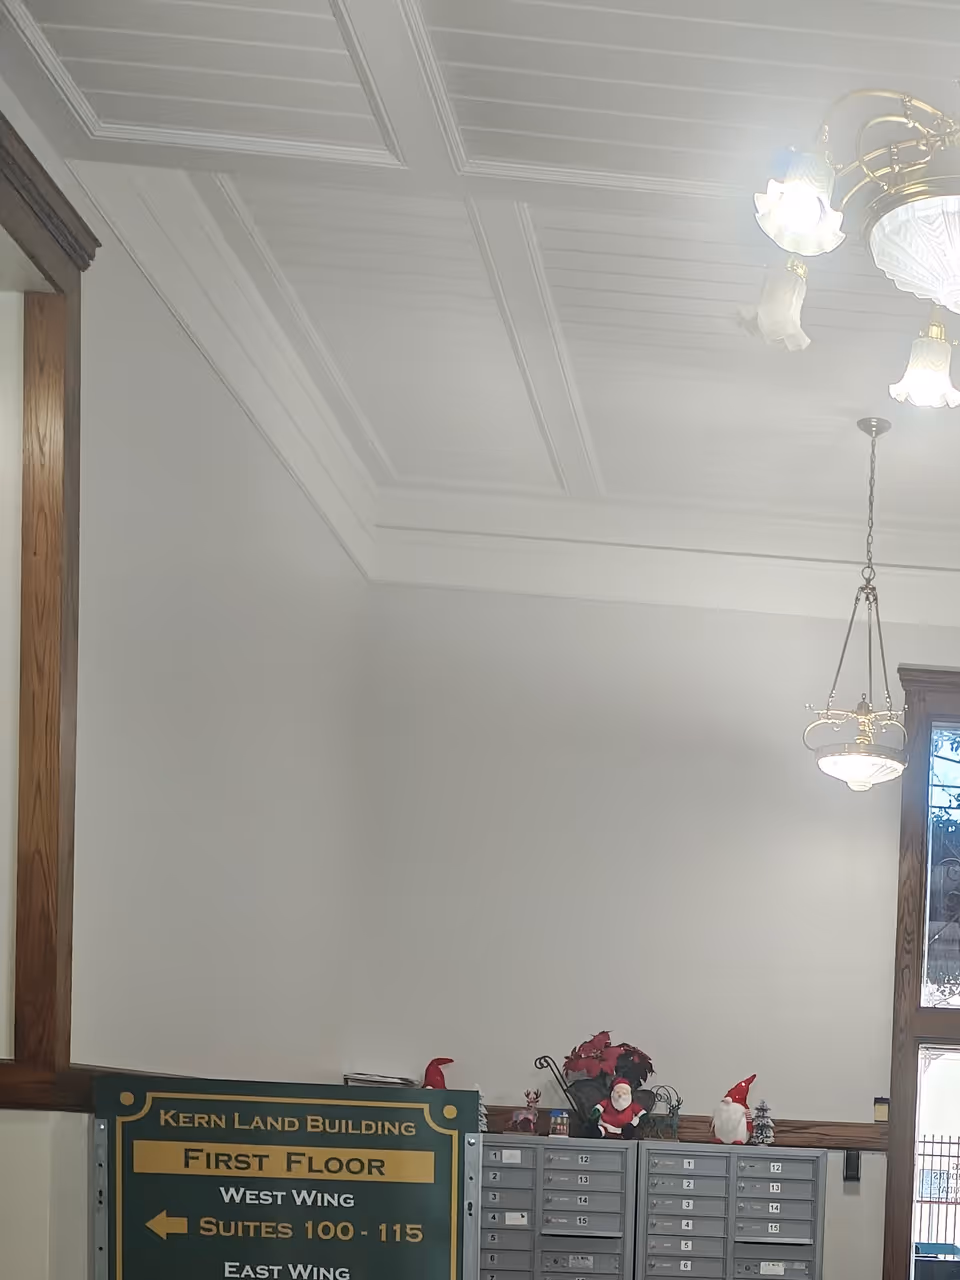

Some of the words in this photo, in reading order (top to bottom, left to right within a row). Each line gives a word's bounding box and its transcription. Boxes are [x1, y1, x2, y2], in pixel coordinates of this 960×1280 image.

[160, 1110, 225, 1130] KERN
[234, 1112, 299, 1132] LAND
[307, 1115, 416, 1136] BUILDING
[492, 1151, 498, 1160] 1
[579, 1155, 590, 1164] 12
[184, 1148, 269, 1171] FIRST
[286, 1152, 385, 1176] FLOOR
[686, 1160, 692, 1168] 1
[771, 1163, 781, 1172] 12
[491, 1171, 499, 1180] 2
[578, 1175, 589, 1184] 13
[685, 1180, 692, 1189] 2
[771, 1184, 780, 1192] 13
[220, 1187, 286, 1205] WEST
[292, 1190, 354, 1207] WING
[491, 1192, 498, 1201] 3
[578, 1196, 588, 1204] 14
[685, 1200, 691, 1209] 3
[770, 1204, 779, 1212] 14
[490, 1213, 497, 1221] 4
[577, 1216, 588, 1225] 15
[199, 1217, 293, 1238] SUITES
[305, 1220, 354, 1240] 100
[379, 1223, 423, 1242] 115
[684, 1221, 690, 1229] 4
[769, 1224, 779, 1232] 15
[489, 1233, 497, 1242] 5
[683, 1241, 690, 1250] 5
[489, 1254, 496, 1263] 6
[682, 1261, 689, 1270] 6
[224, 1262, 282, 1279] EAST
[289, 1264, 350, 1280] WING
